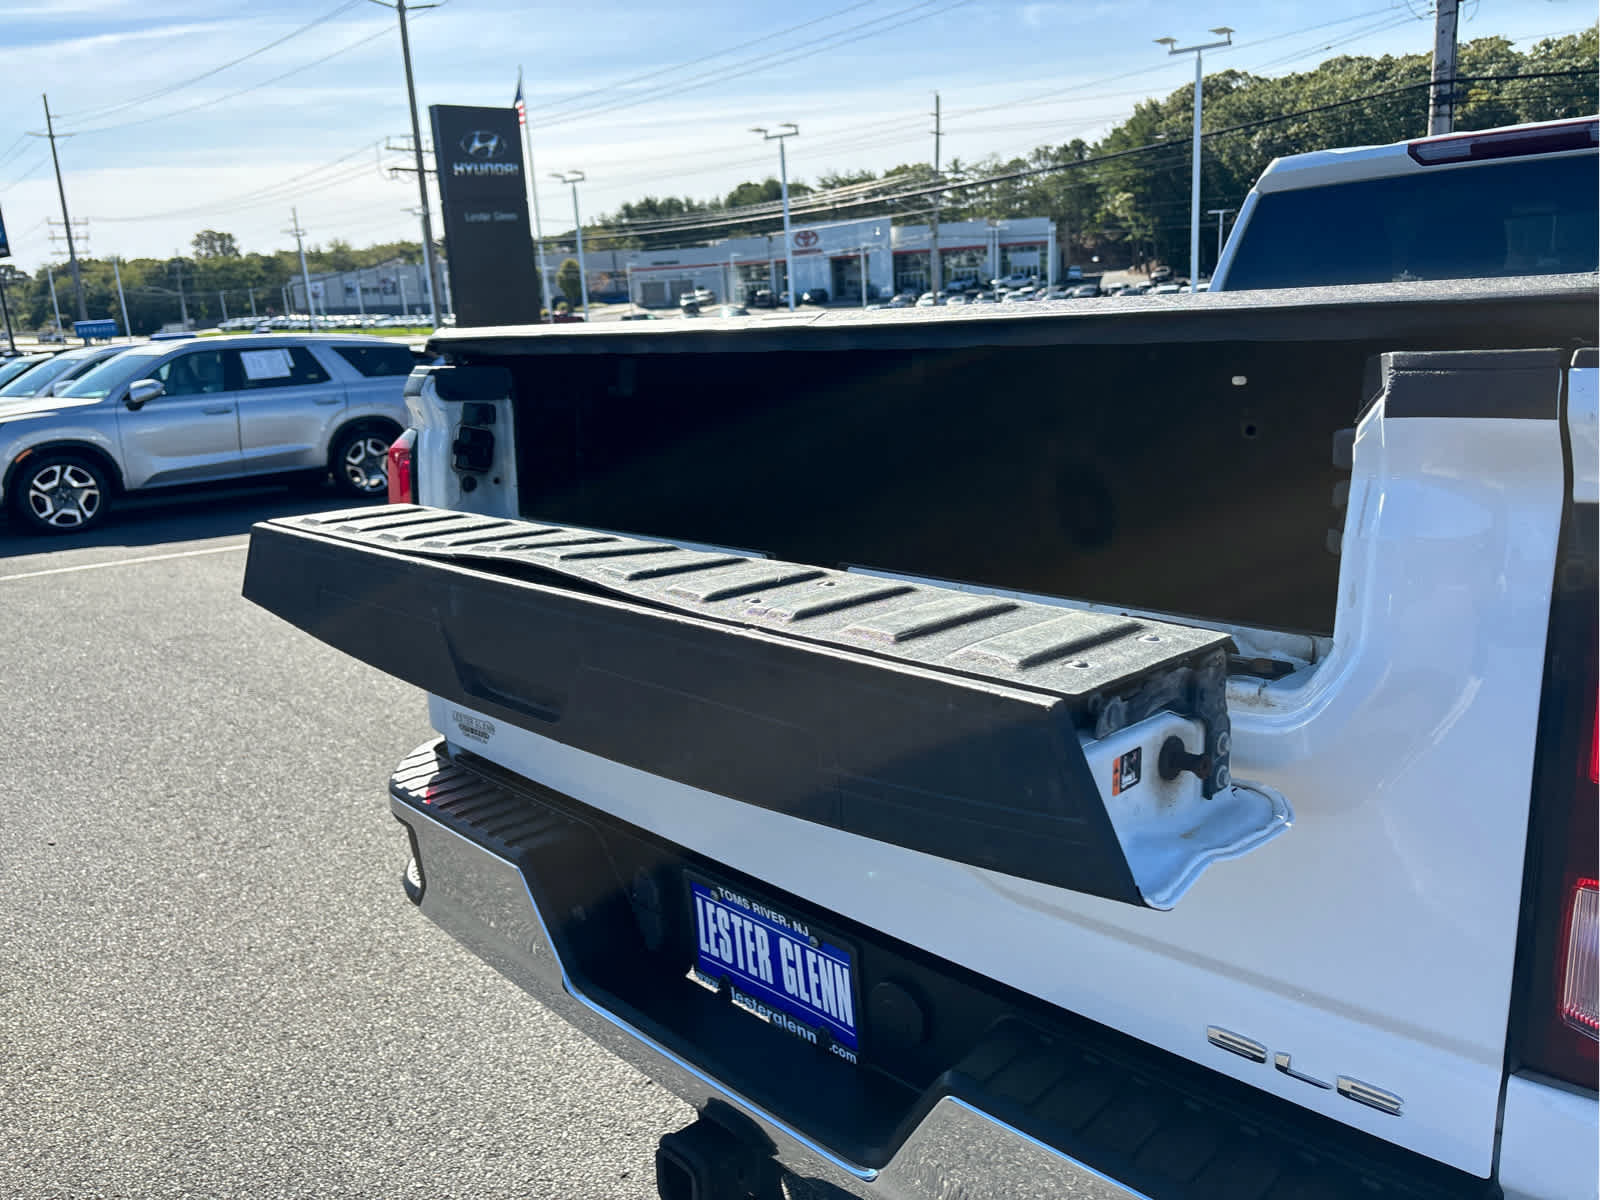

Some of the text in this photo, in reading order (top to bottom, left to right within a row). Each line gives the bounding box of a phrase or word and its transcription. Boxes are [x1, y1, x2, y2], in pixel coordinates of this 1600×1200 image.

[453, 163, 519, 176] HYUNDAI
[717, 886, 750, 910] TOMS
[792, 920, 809, 937] NJ
[696, 896, 855, 1029] LESTER GLENN
[1207, 1024, 1404, 1117] SLE
